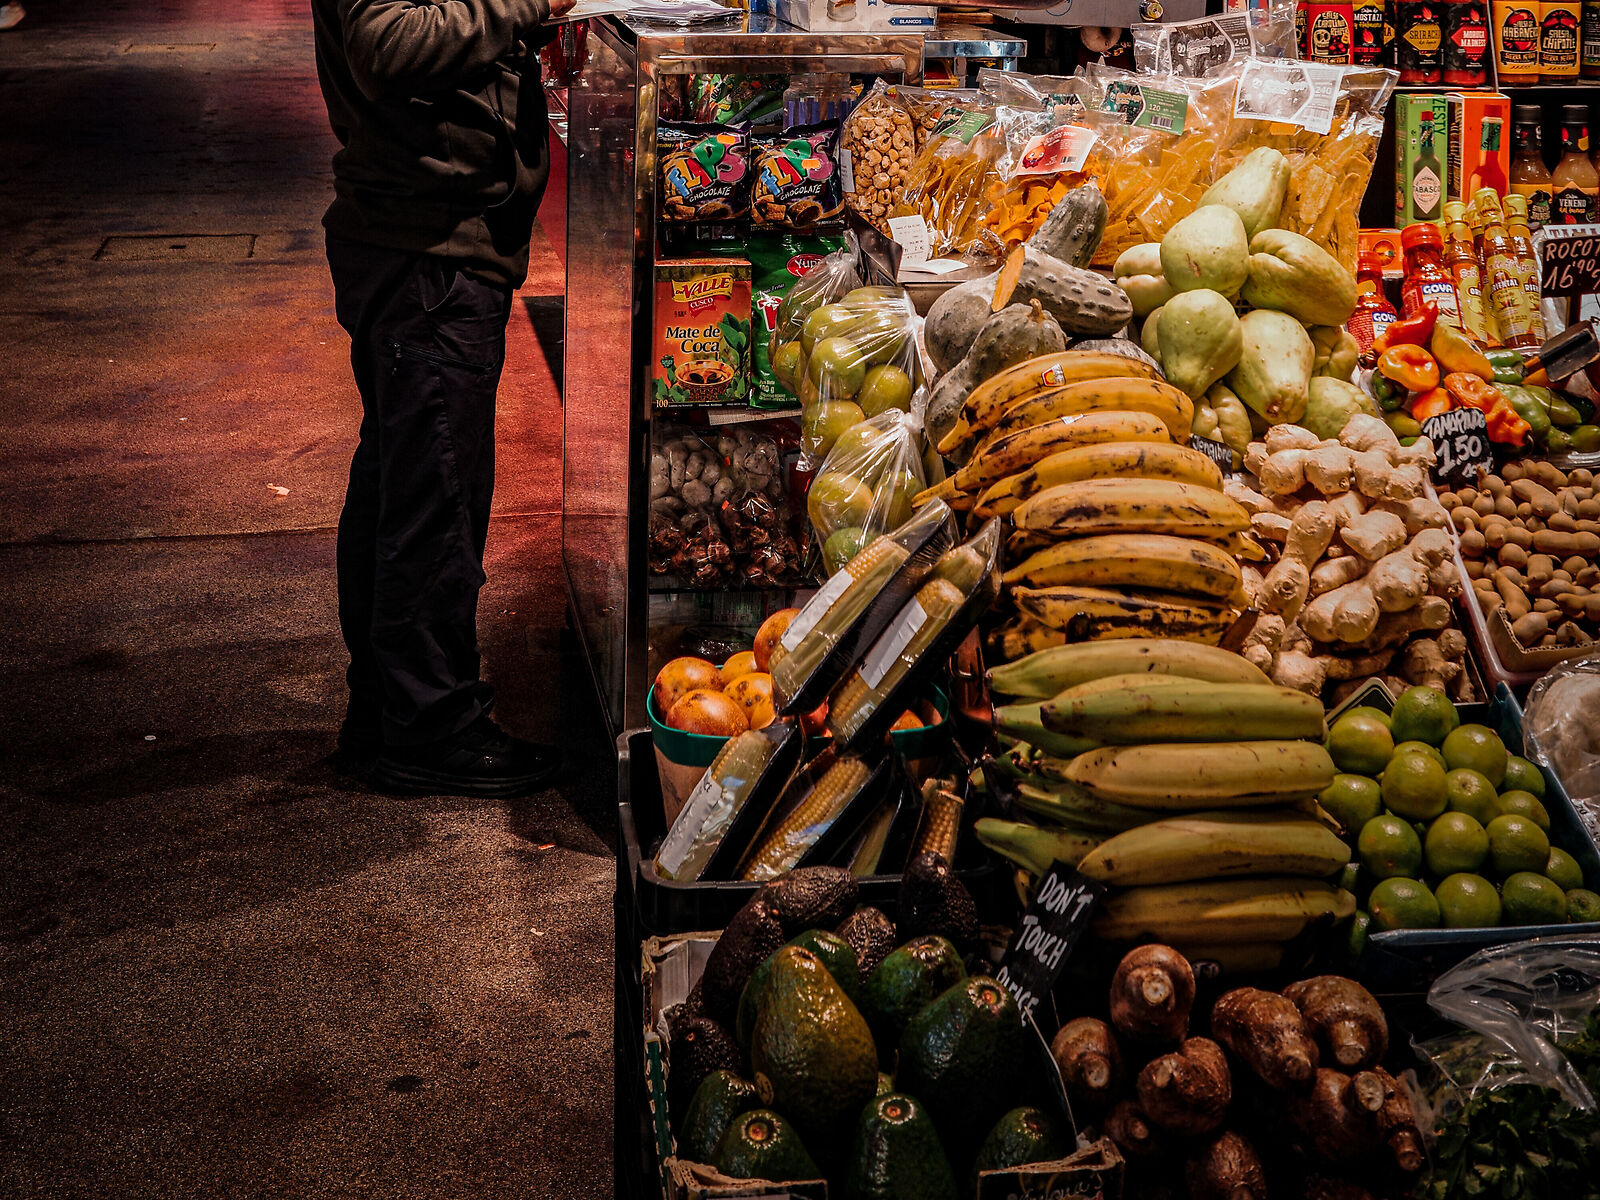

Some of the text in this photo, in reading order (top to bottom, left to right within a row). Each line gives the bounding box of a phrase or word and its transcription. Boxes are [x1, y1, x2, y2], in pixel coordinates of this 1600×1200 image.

[1549, 29, 1569, 38] SALSA
[1234, 37, 1249, 47] 240
[1149, 103, 1161, 112] 120
[1432, 98, 1446, 136] ZESTY
[689, 186, 732, 203] CHOCOLATE
[780, 184, 822, 201] CHOCOLATE
[1559, 198, 1587, 208] VENENO
[682, 277, 731, 299] VALLE
[1423, 284, 1453, 295] GOYA
[690, 297, 714, 309] CUSCO
[665, 325, 720, 339] Mate de
[681, 339, 720, 353] Coca
[656, 399, 669, 408] 100
[1037, 872, 1094, 923] DON'T
[1015, 915, 1067, 970] TOUCH
